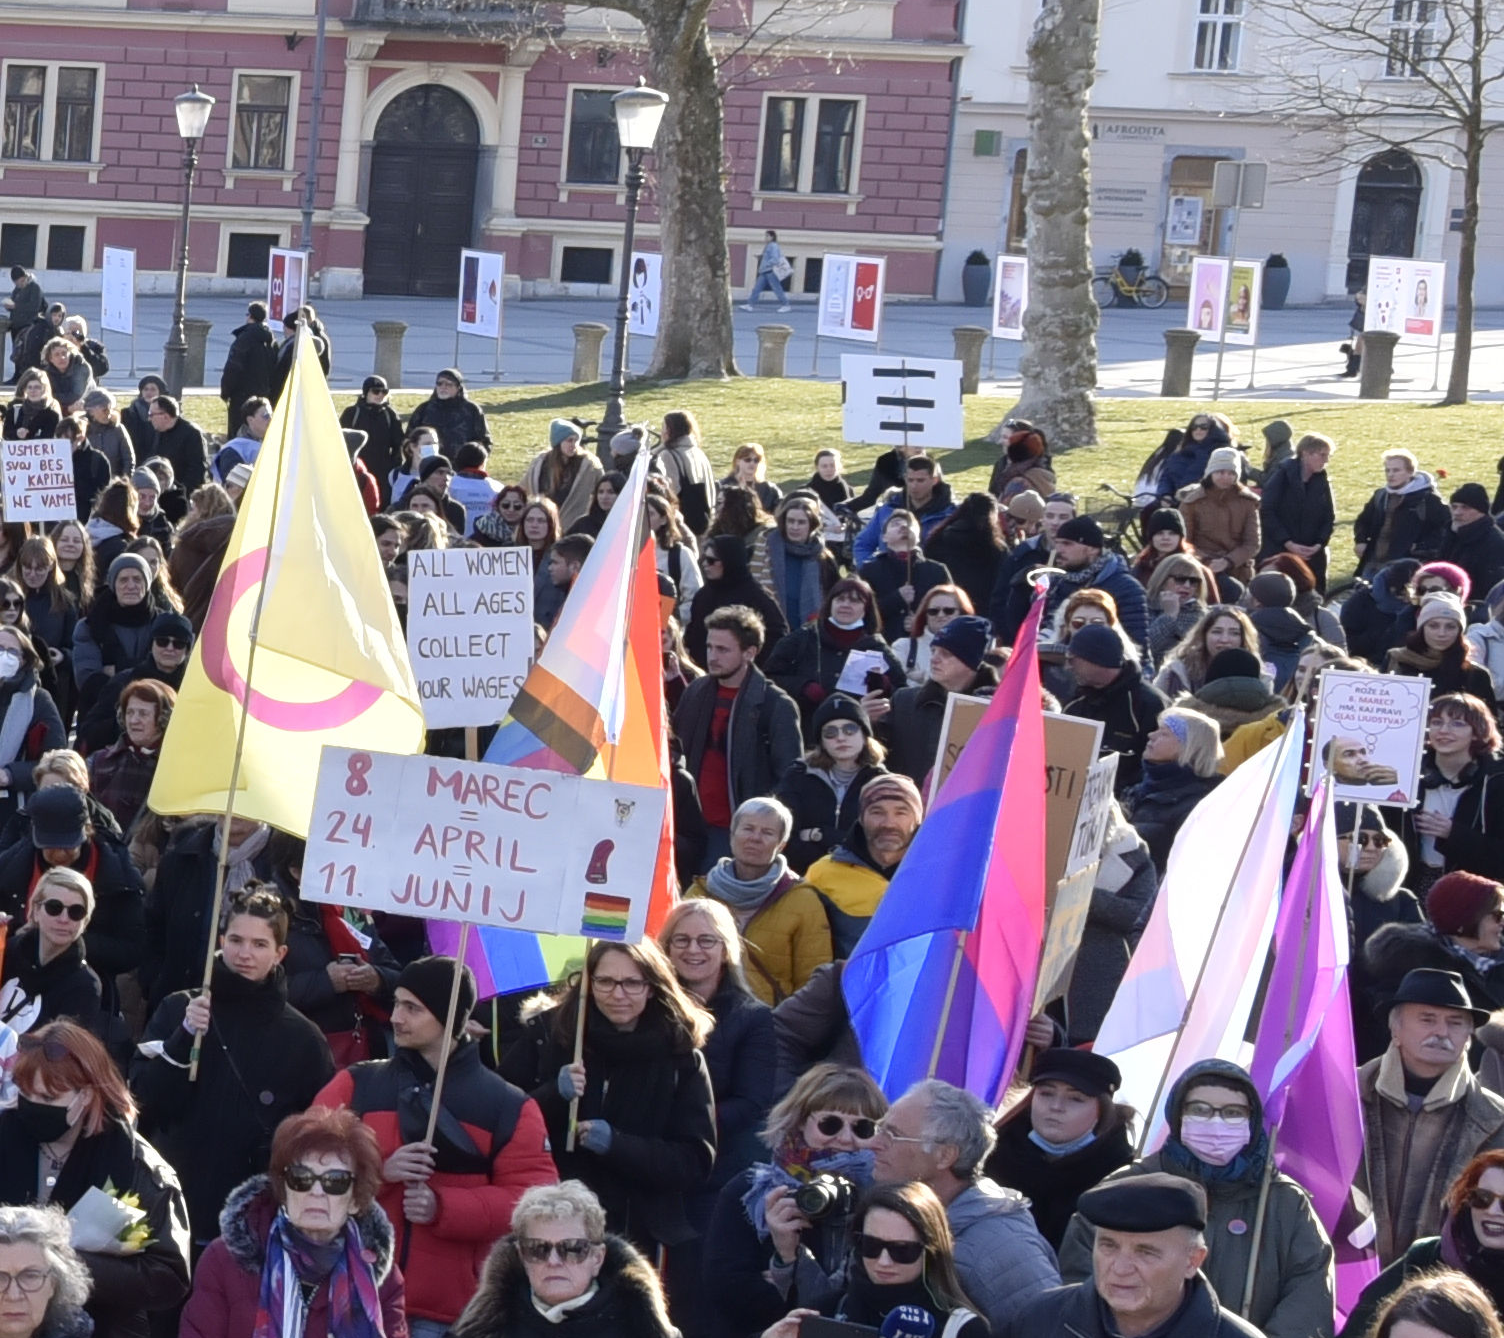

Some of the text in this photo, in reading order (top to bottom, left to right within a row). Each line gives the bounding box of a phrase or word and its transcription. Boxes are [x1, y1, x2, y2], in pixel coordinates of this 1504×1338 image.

[7, 443, 55, 457] USMERI
[5, 459, 64, 472] SVOJ BES
[7, 473, 75, 488] V KAPITAL
[12, 495, 32, 509] NE
[412, 548, 529, 578] ALL WOMEN
[423, 591, 525, 617] ALL AGES
[418, 633, 511, 659] COLLECT
[462, 675, 525, 699] WAGES
[1355, 686, 1391, 697] ROŽE ZA
[1358, 697, 1395, 707] MAREC?
[1334, 712, 1356, 721] GLAS
[1359, 706, 1374, 715] KAJ
[1376, 707, 1402, 717] PRAVI
[345, 752, 552, 819] 8. MAREC
[325, 810, 537, 873] 24. APRIL
[319, 861, 525, 923] 11. JUNIJ
